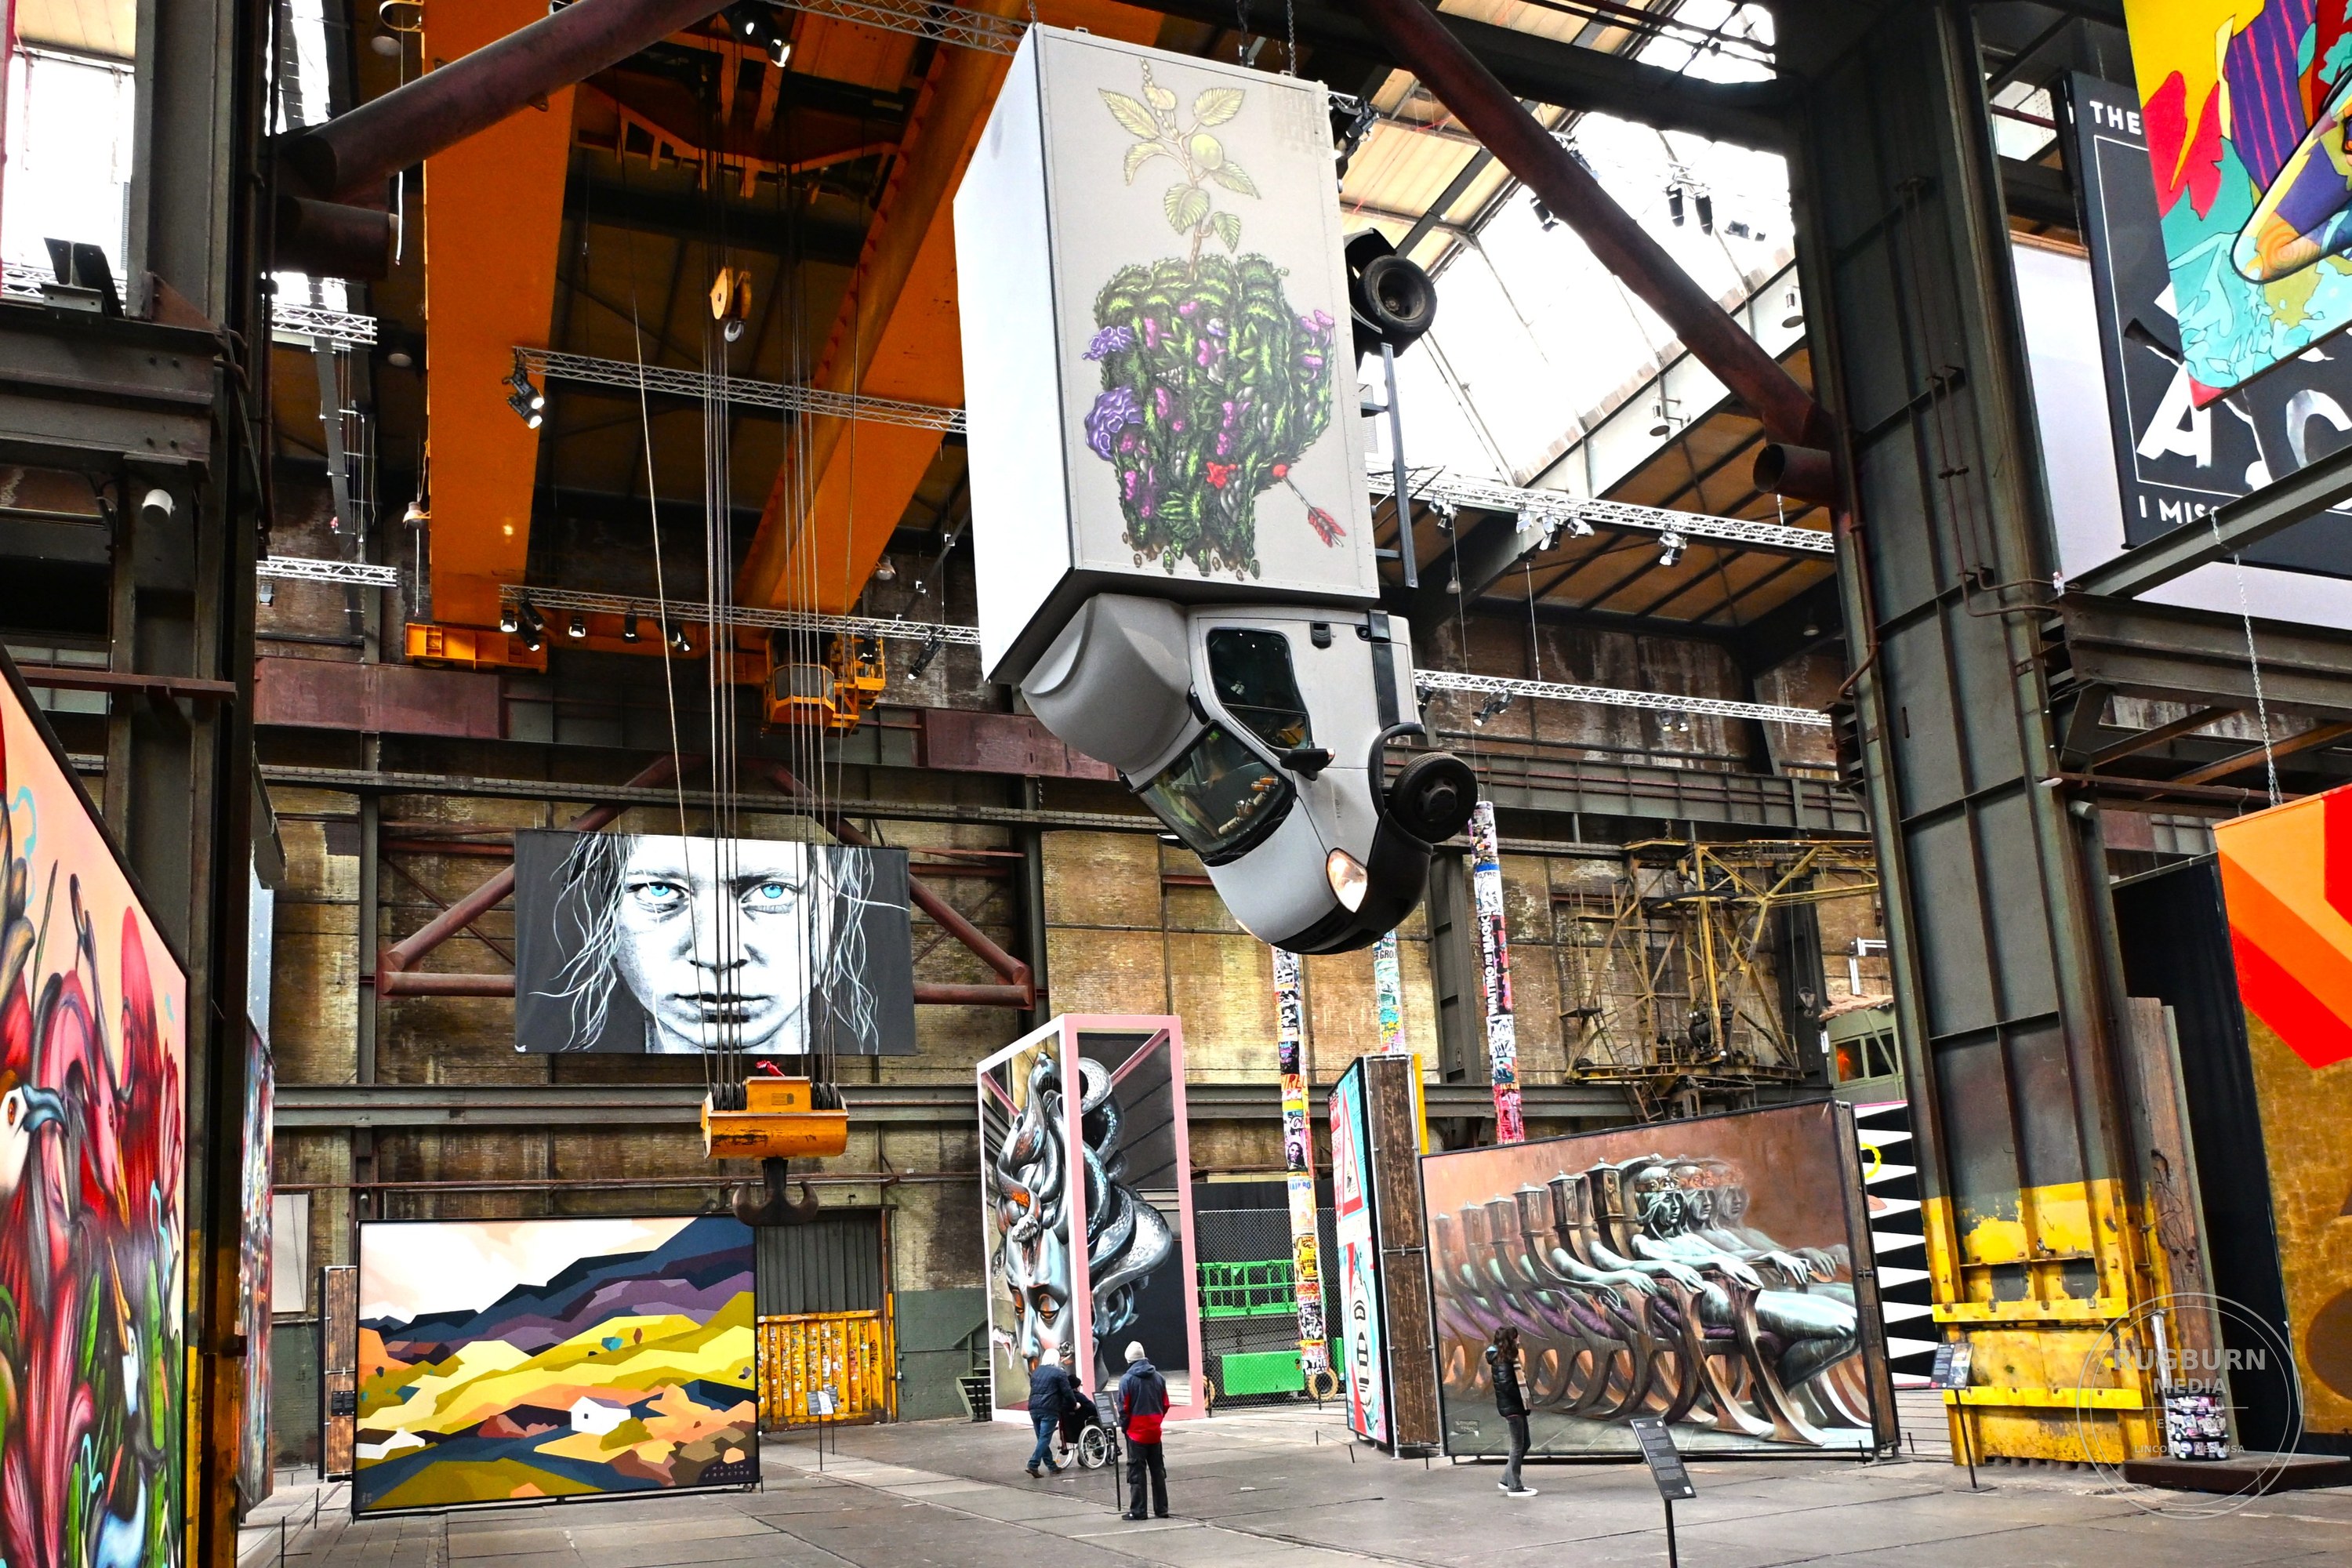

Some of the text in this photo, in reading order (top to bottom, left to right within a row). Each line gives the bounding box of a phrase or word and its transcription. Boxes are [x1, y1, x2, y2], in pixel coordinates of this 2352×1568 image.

[2089, 100, 2142, 135] THE
[2139, 495, 2220, 524] I MIS
[1485, 966, 1498, 1016] WAITING
